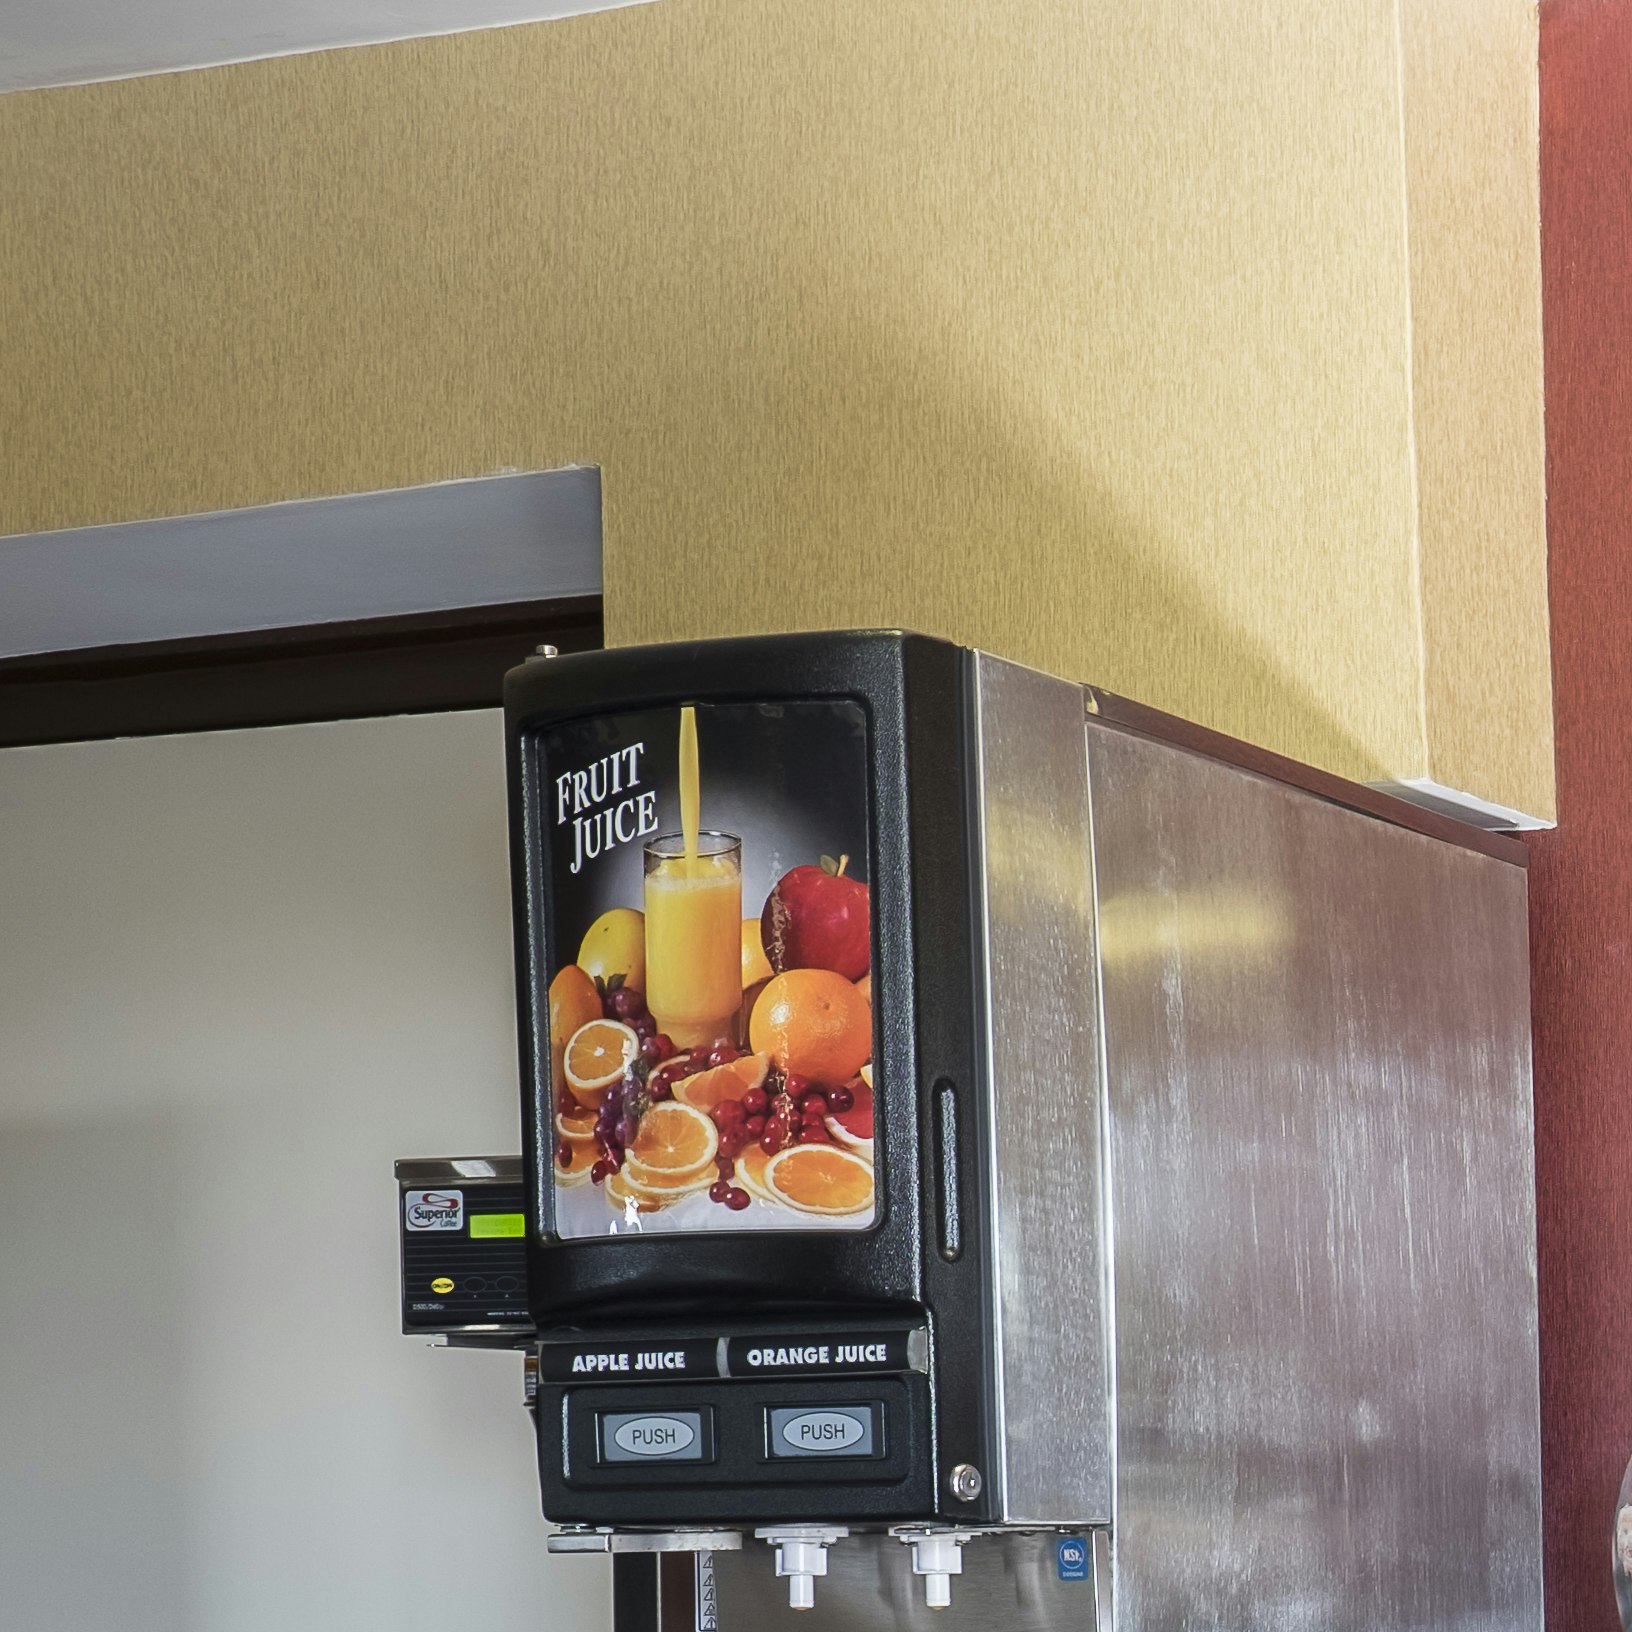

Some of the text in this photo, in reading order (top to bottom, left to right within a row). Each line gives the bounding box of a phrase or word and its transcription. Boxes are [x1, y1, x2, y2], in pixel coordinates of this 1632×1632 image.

[556, 742, 644, 825] FRUIT
[570, 791, 658, 873] JUICE
[414, 1206, 460, 1223] Superior
[572, 1352, 685, 1372] APPLE JUICE
[747, 1344, 887, 1367] ORANGE JUICE
[633, 1428, 676, 1445] PUSH
[801, 1424, 845, 1440] PUSH
